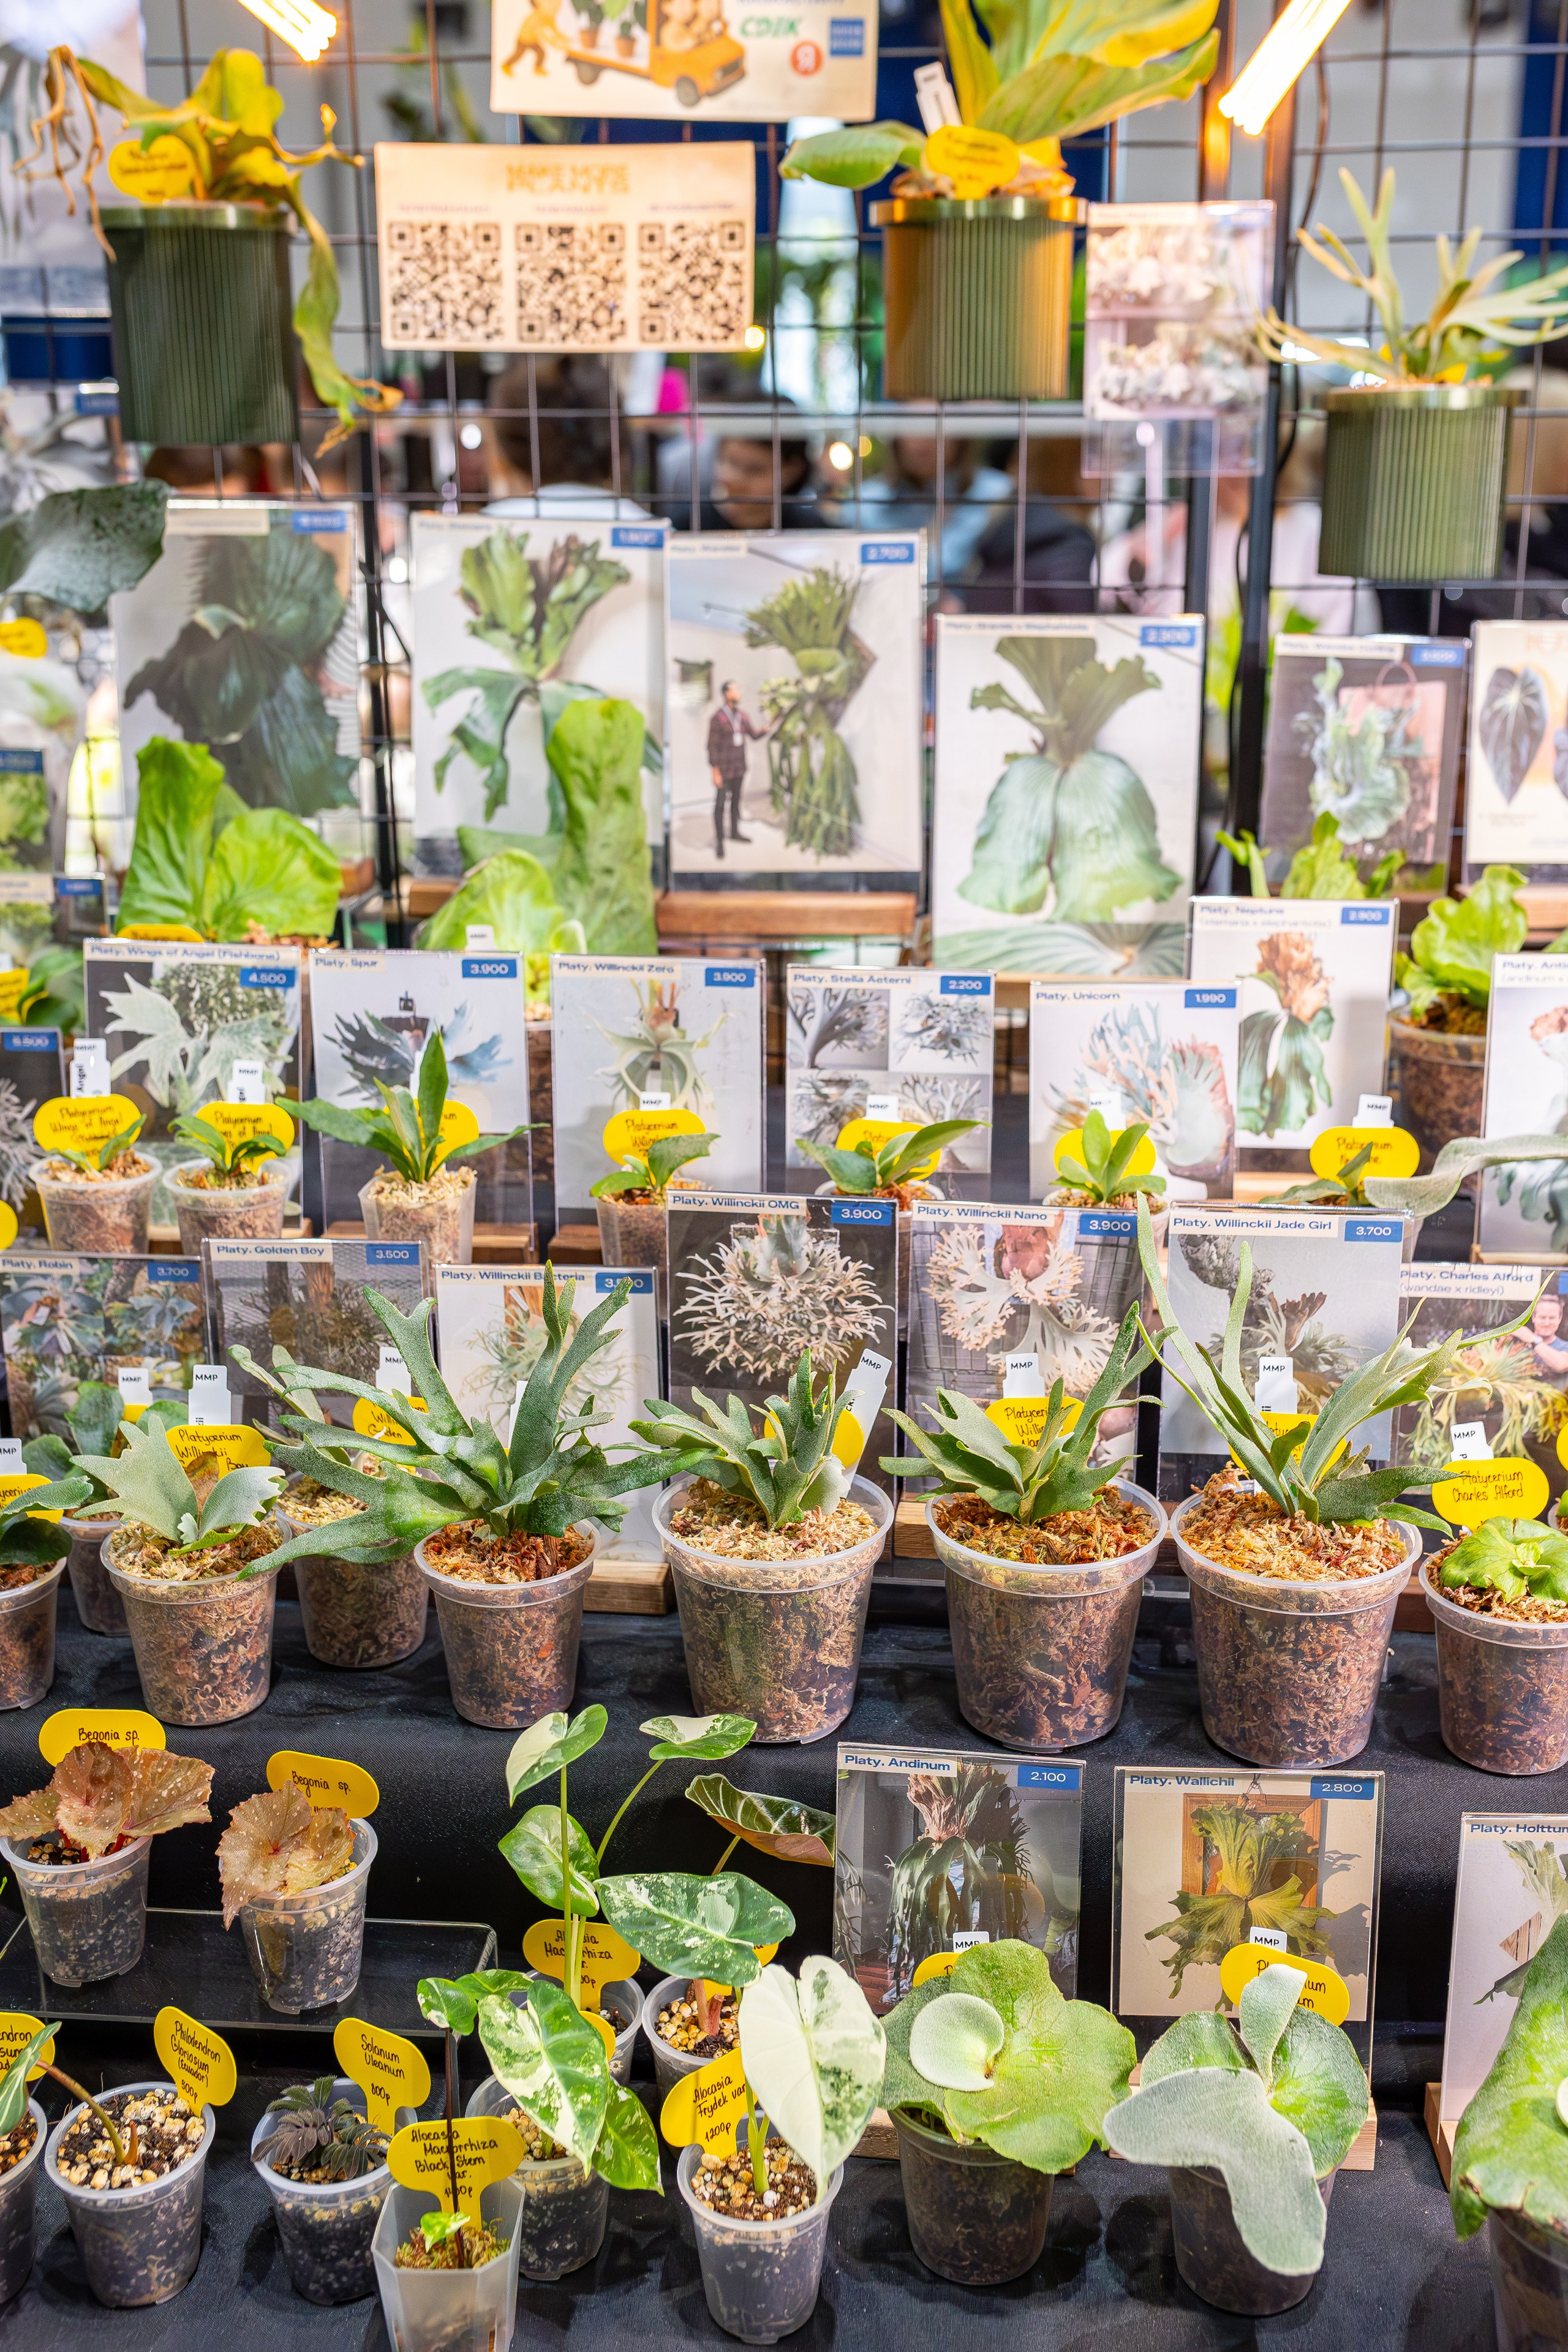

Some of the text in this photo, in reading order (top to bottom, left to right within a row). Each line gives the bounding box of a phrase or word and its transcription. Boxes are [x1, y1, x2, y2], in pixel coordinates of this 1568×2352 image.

[91, 946, 123, 956] Platy.
[128, 947, 164, 957] Wings
[181, 949, 215, 959] Angel
[316, 958, 349, 968] Platy.
[559, 962, 592, 972] Platy.
[794, 974, 827, 984] Platy.
[831, 975, 864, 984] Stella
[1036, 992, 1070, 1001] Platy.
[673, 1196, 800, 1209] Platy. Willinckii OMG
[841, 1209, 883, 1219] 3.900
[918, 1206, 1047, 1221] Platy. Willinckii Nano
[1089, 1220, 1131, 1231] 3.900
[1173, 1218, 1332, 1229] Platy. Willinckii Jade Girl
[1356, 1226, 1392, 1235] 3.700
[217, 1246, 325, 1257] Platy. Golden Boy
[376, 1250, 410, 1259] 3.500
[1, 1259, 73, 1270] Platy. Robin
[442, 1271, 476, 1281] Platy.
[479, 1271, 530, 1280] Willinckii
[1400, 1270, 1534, 1283] Platy. Charles Alford
[605, 1278, 644, 1288] 3.0
[1400, 1284, 1452, 1293] (wandae
[1465, 1284, 1505, 1296] ridleyi)
[861, 1356, 881, 1370] MMP
[1454, 1430, 1476, 1440] MMP
[1460, 1471, 1523, 1488] Platycerium
[1452, 1483, 1523, 1503] Charles Alford
[78, 1727, 140, 1746] Begonia sp.
[845, 1755, 951, 1771] Platy. Andinum
[1030, 1771, 1067, 1783] 2.100
[1129, 1774, 1235, 1787] Platy. Wallichii
[292, 1770, 352, 1798] Begonia sp.
[1322, 1783, 1363, 1793] 2.800
[1471, 1824, 1512, 1834] Platy.
[955, 1940, 980, 1950] MMP
[1254, 1936, 1280, 1947] MMP
[175, 2020, 221, 2064] Philodendron
[171, 2034, 209, 2074] Gloriosum
[361, 2034, 400, 2064] Solanum
[364, 2052, 405, 2080] Uleanum
[178, 2057, 208, 2088] (Ecuador)
[693, 2076, 733, 2103] Alocasia
[696, 2091, 728, 2118] Frydek
[411, 2128, 460, 2143] Alocasa
[415, 2154, 486, 2173] Black Stem
